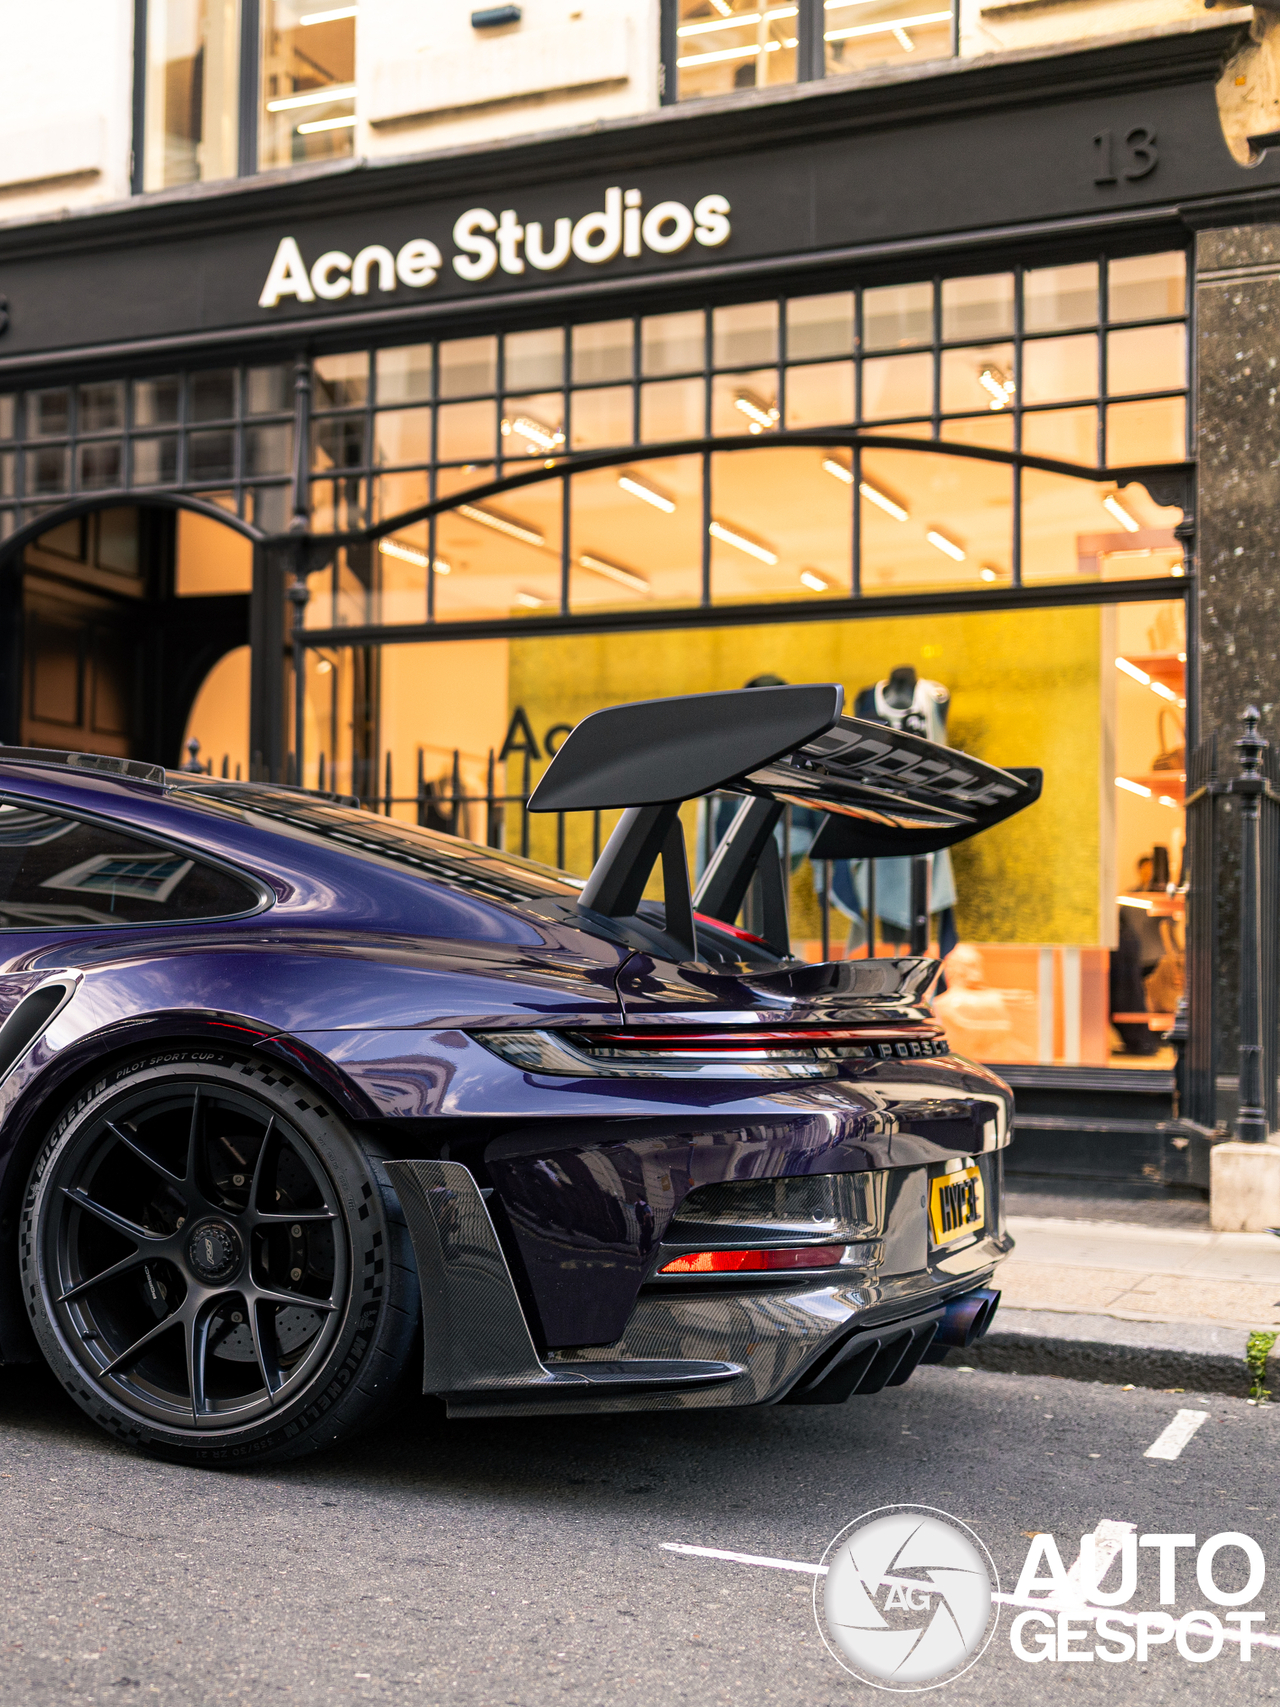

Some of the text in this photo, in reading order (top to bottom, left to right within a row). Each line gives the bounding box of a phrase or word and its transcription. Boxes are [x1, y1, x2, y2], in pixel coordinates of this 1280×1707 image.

[1092, 125, 1160, 187] 13
[258, 187, 731, 308] Acne Studios
[36, 1077, 108, 1178] MICHELIN
[115, 1060, 147, 1079] PILOT
[149, 1052, 188, 1065] SPORT
[190, 1052, 215, 1061] CUP
